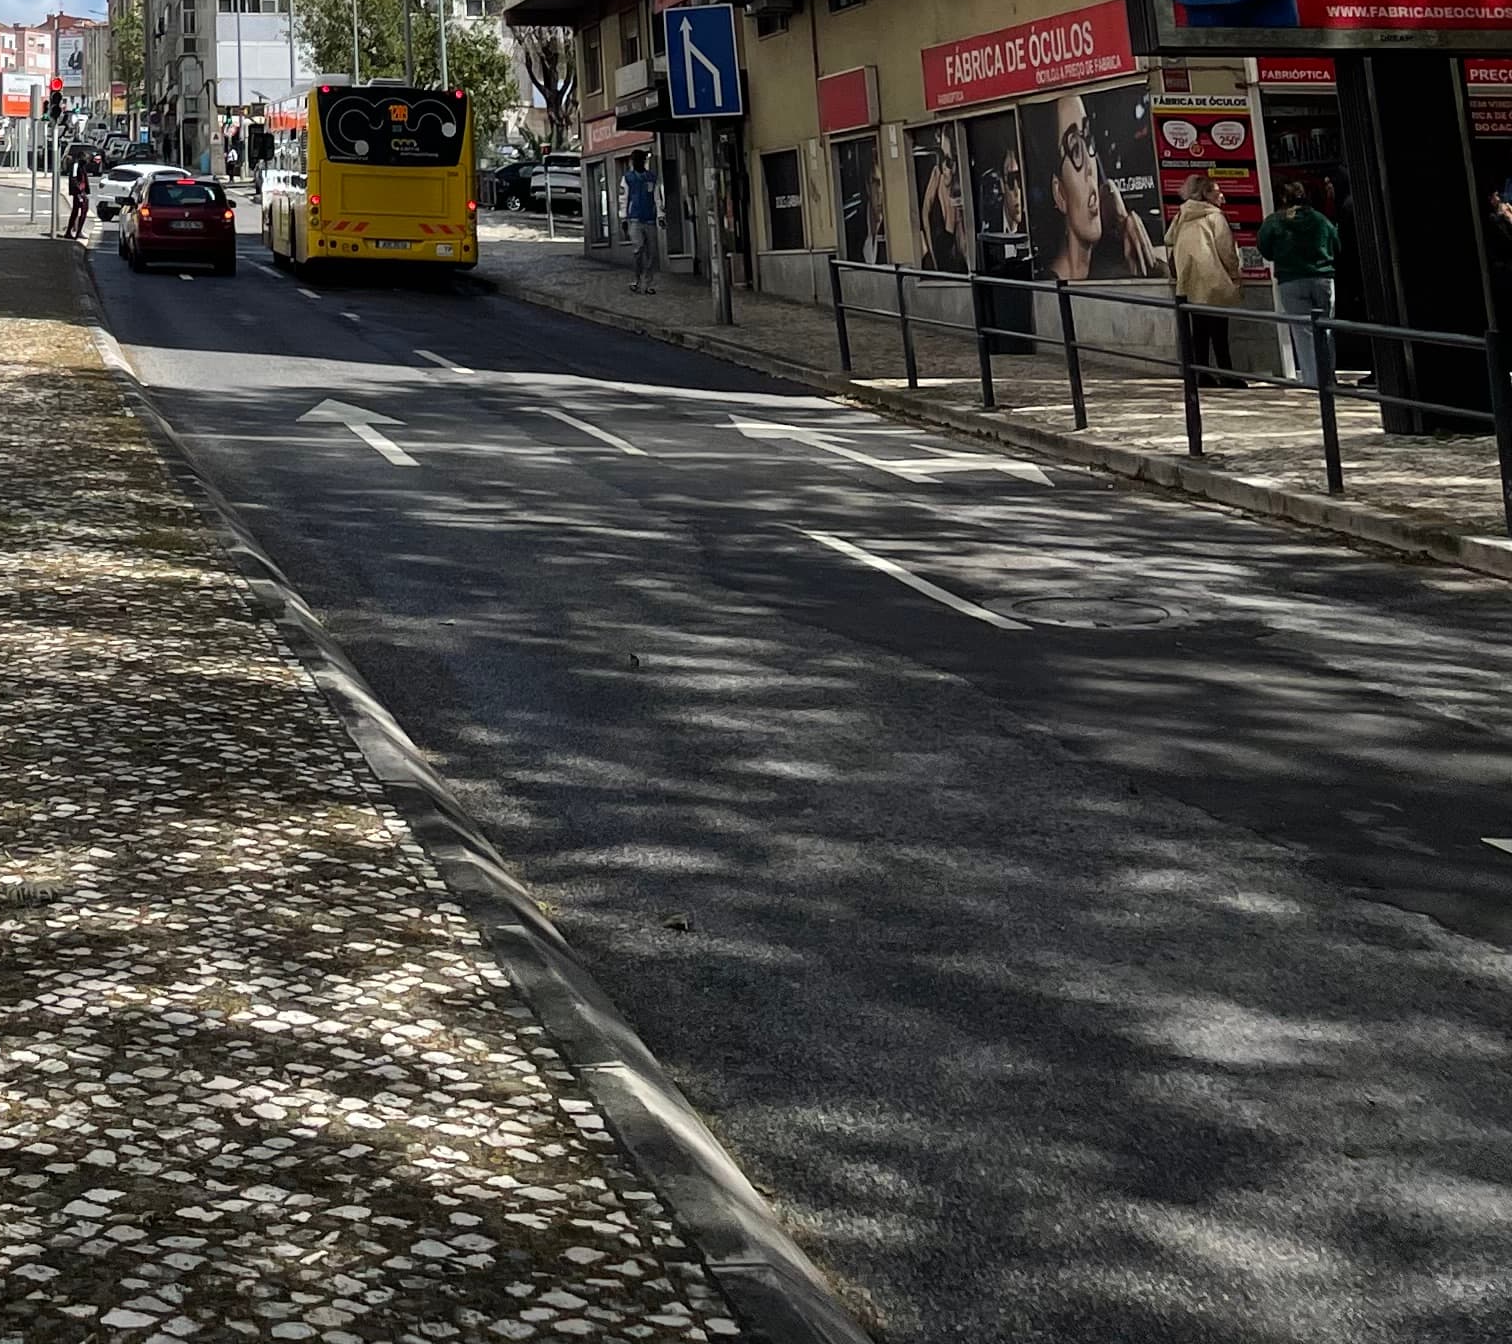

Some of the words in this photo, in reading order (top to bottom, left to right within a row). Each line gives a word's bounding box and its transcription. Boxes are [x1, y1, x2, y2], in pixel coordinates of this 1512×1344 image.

[945, 45, 1007, 87] FÁBRICA
[1005, 37, 1026, 72] DE
[1028, 20, 1094, 68] ÓCULOS
[1261, 69, 1331, 80] FABRIÓPTICA
[1469, 68, 1512, 83] PREÇ
[1153, 96, 1194, 106] FÁBRICA
[1196, 98, 1208, 106] DE
[1209, 96, 1247, 106] ÓCULOS
